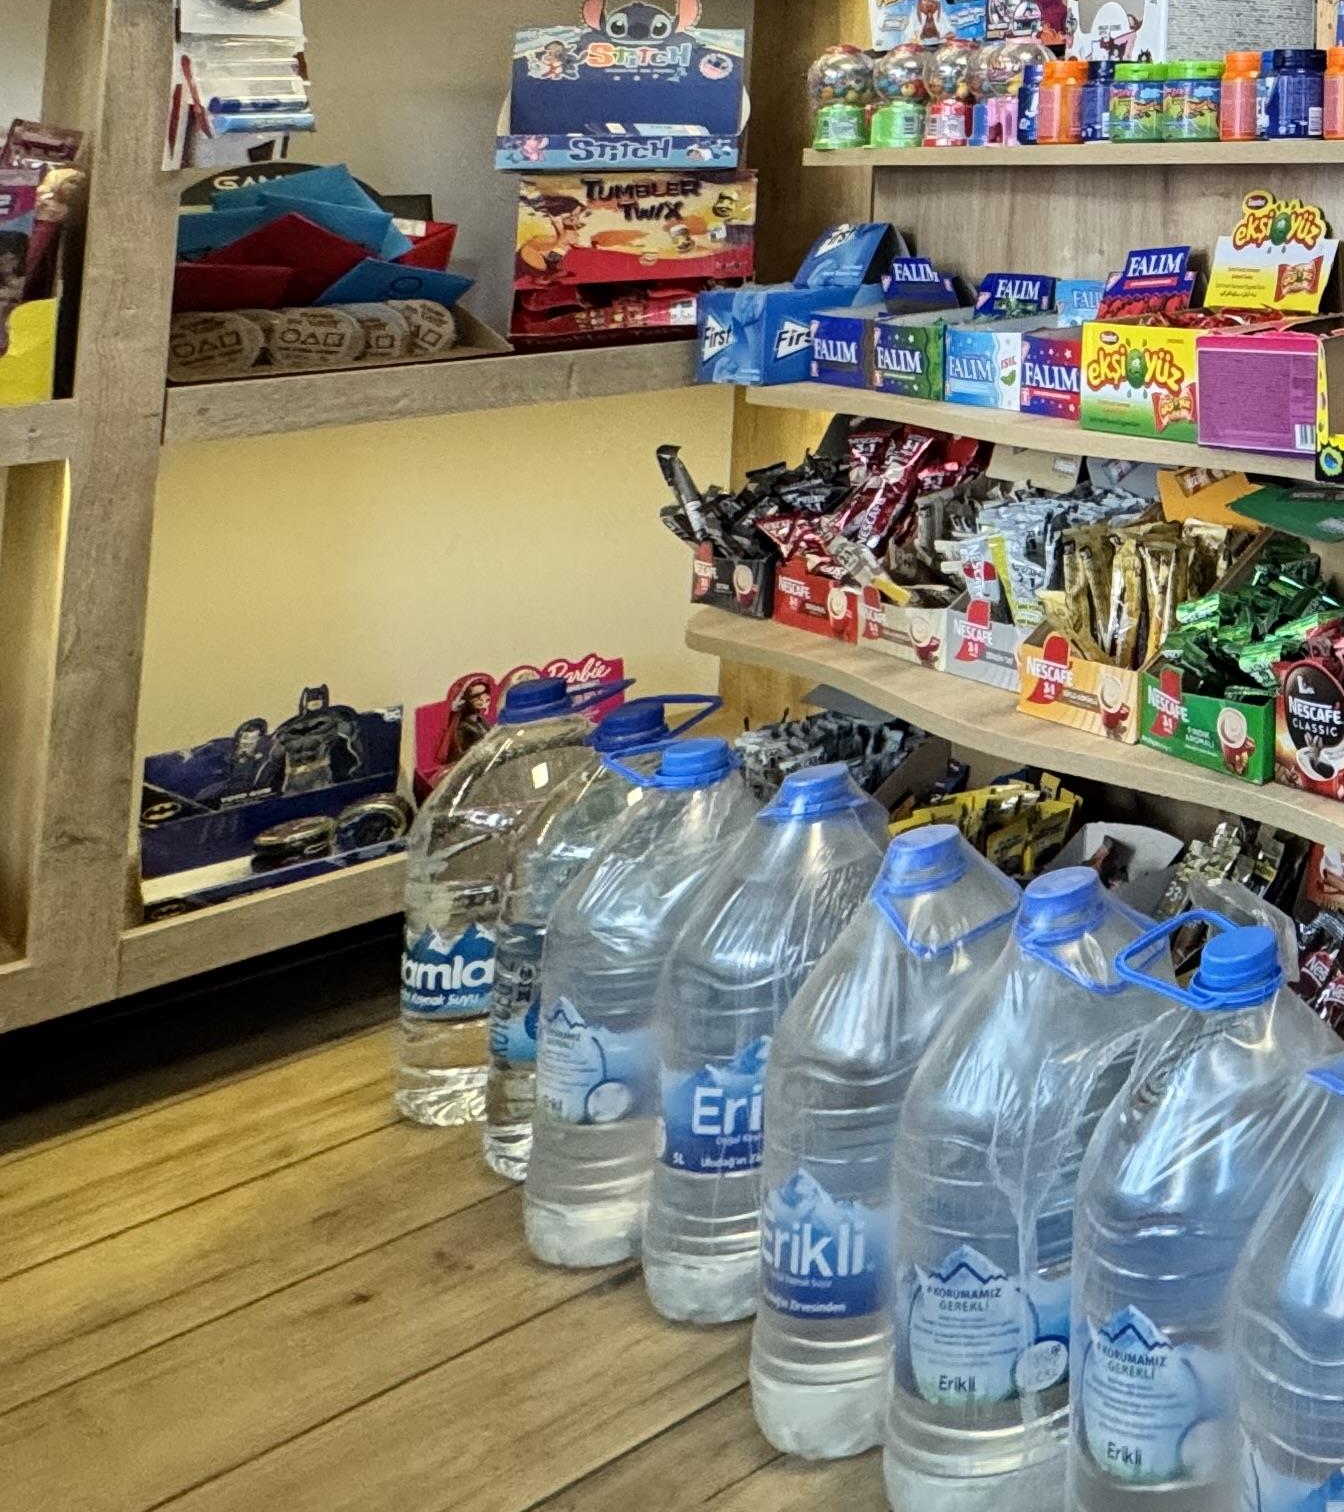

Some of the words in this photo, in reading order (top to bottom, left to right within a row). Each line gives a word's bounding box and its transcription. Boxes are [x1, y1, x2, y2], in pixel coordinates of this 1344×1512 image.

[213, 174, 284, 192] GAM
[581, 179, 702, 200] TUMBLER
[621, 201, 685, 222] TWIX
[892, 262, 939, 283] FALIM
[1128, 252, 1185, 277] FALIM
[995, 277, 1041, 301] FALIM
[1072, 288, 1103, 309] FALI
[775, 326, 812, 351] Firs
[814, 338, 858, 364] FALIM
[876, 347, 922, 373] FALIM
[948, 355, 993, 382] FALIM
[1024, 361, 1080, 392] FALIM
[1292, 717, 1338, 738] CLASSIC
[692, 1087, 763, 1137] Eri
[937, 1375, 978, 1394] Erikli
[1106, 1440, 1143, 1467] Erikli
